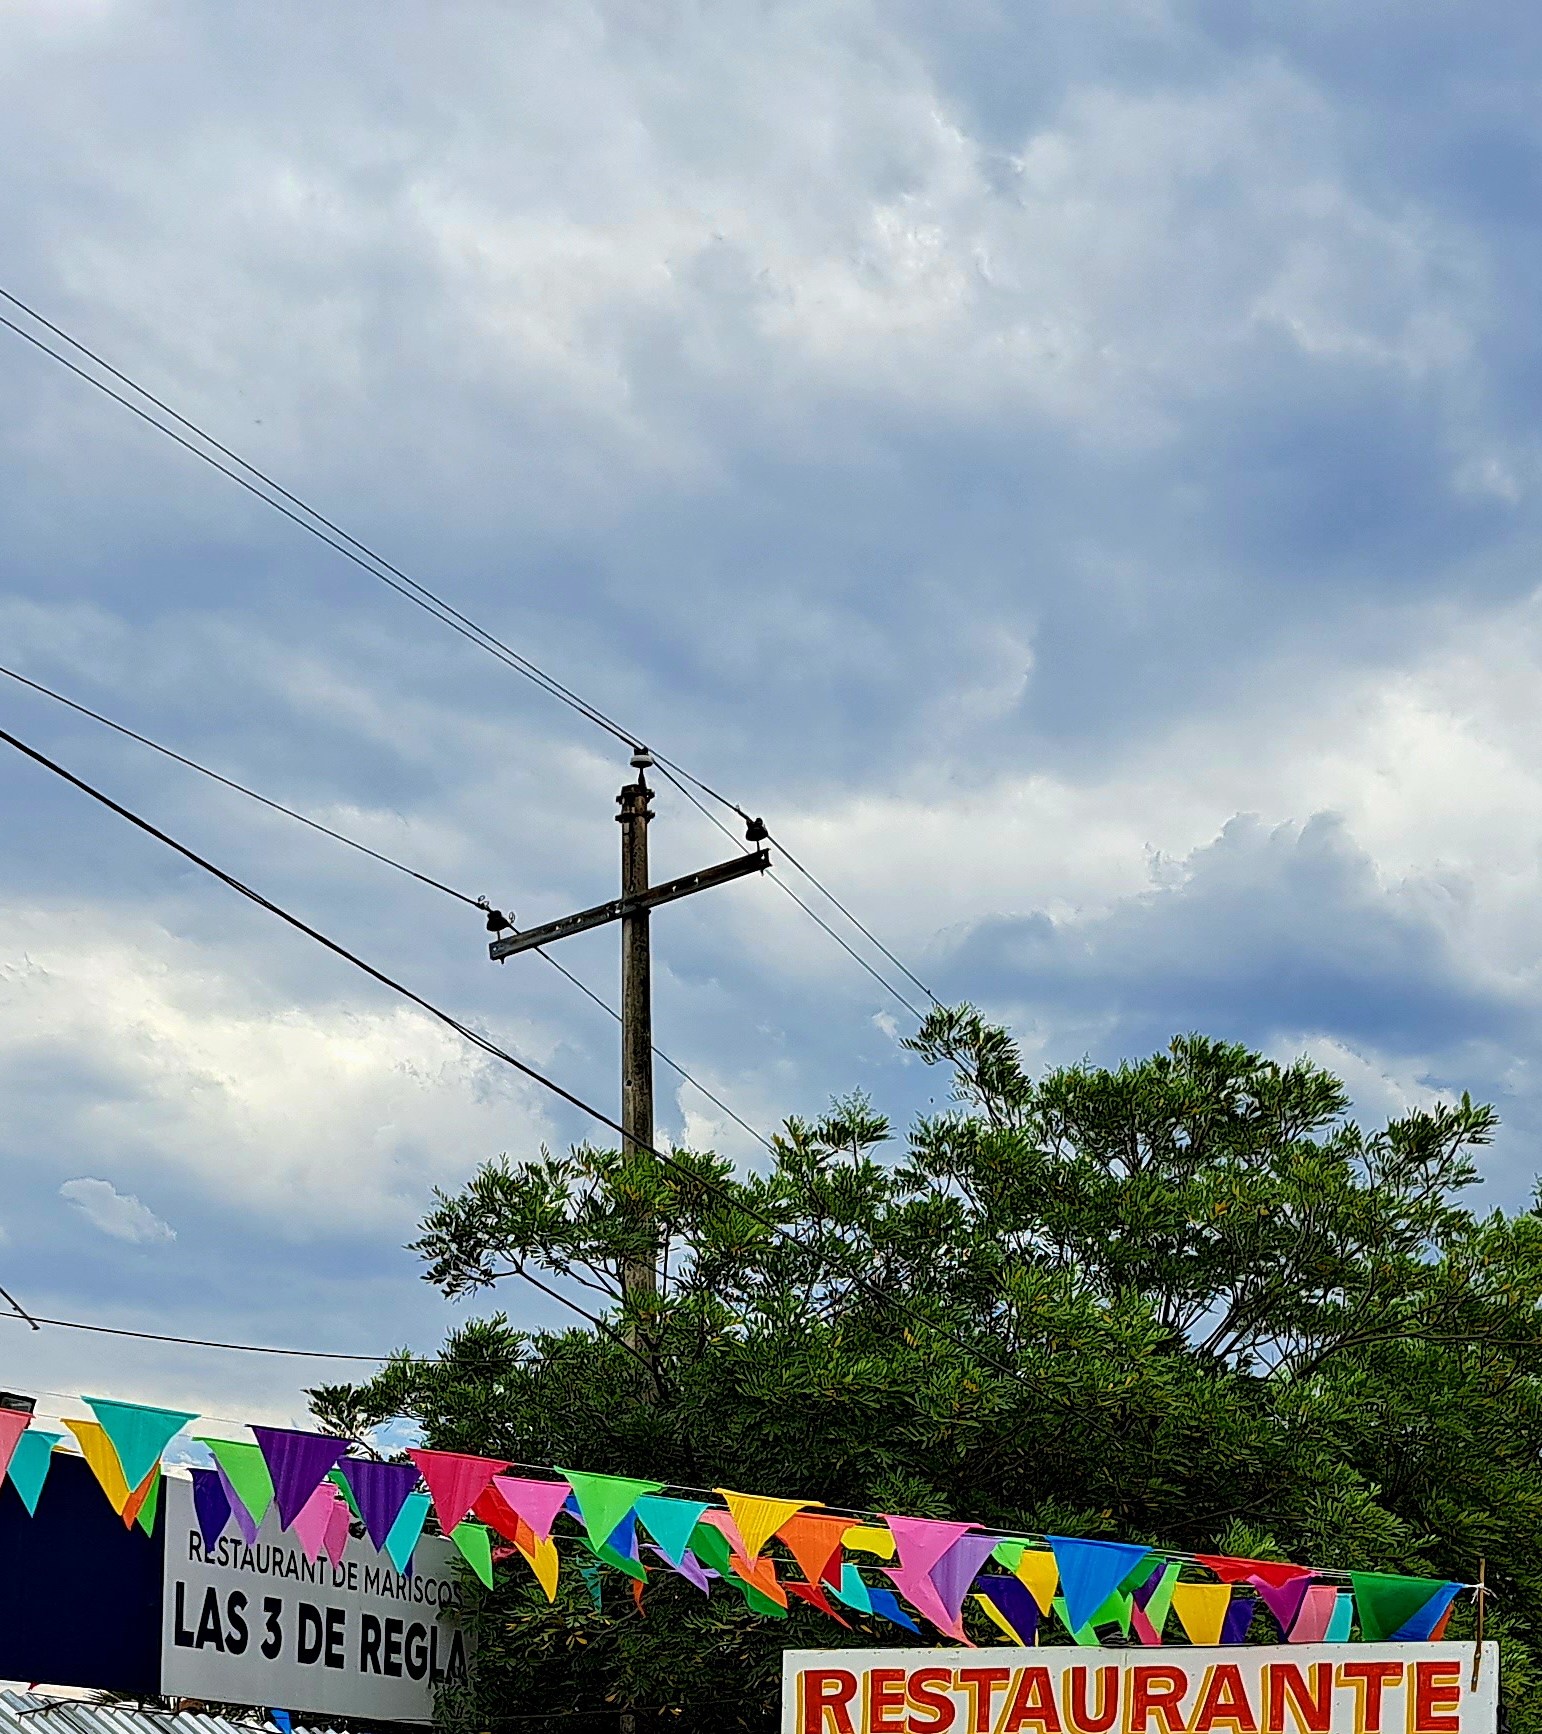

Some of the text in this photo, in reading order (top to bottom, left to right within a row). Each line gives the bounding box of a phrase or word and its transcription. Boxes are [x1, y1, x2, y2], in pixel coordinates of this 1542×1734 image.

[332, 1559, 358, 1591] DE
[174, 1580, 468, 1686] LAS 3 DE REGLA
